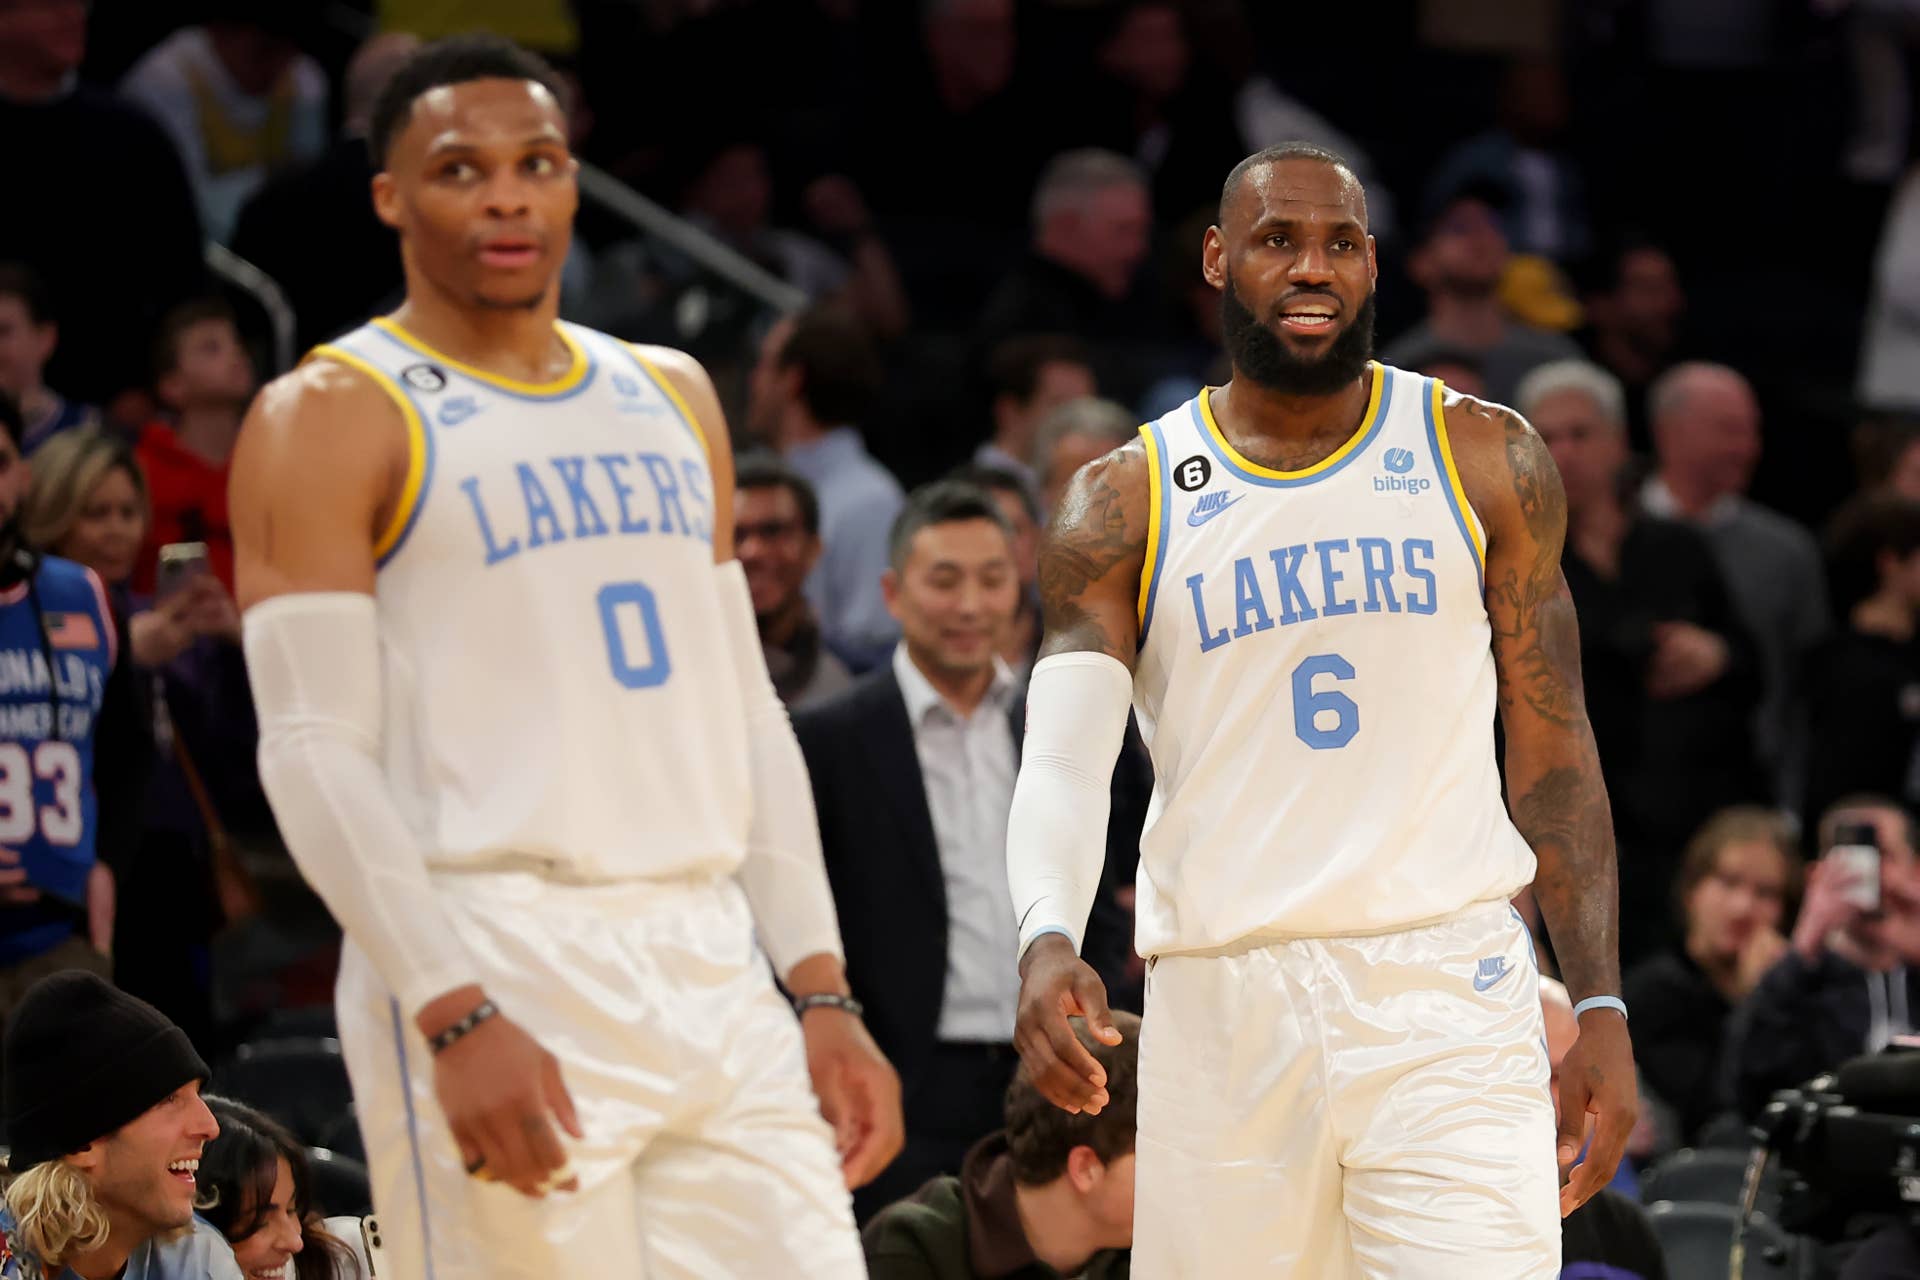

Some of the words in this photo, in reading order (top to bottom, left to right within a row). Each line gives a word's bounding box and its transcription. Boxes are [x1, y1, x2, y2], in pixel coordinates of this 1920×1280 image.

[1183, 460, 1204, 488] 6
[1195, 490, 1230, 513] NIKE
[1373, 476, 1430, 495] bibigo
[459, 452, 715, 566] LAKERS
[1186, 537, 1438, 653] LAKERS
[596, 580, 672, 690] 0
[1292, 653, 1360, 750] 6
[1478, 955, 1505, 976] NIKE
